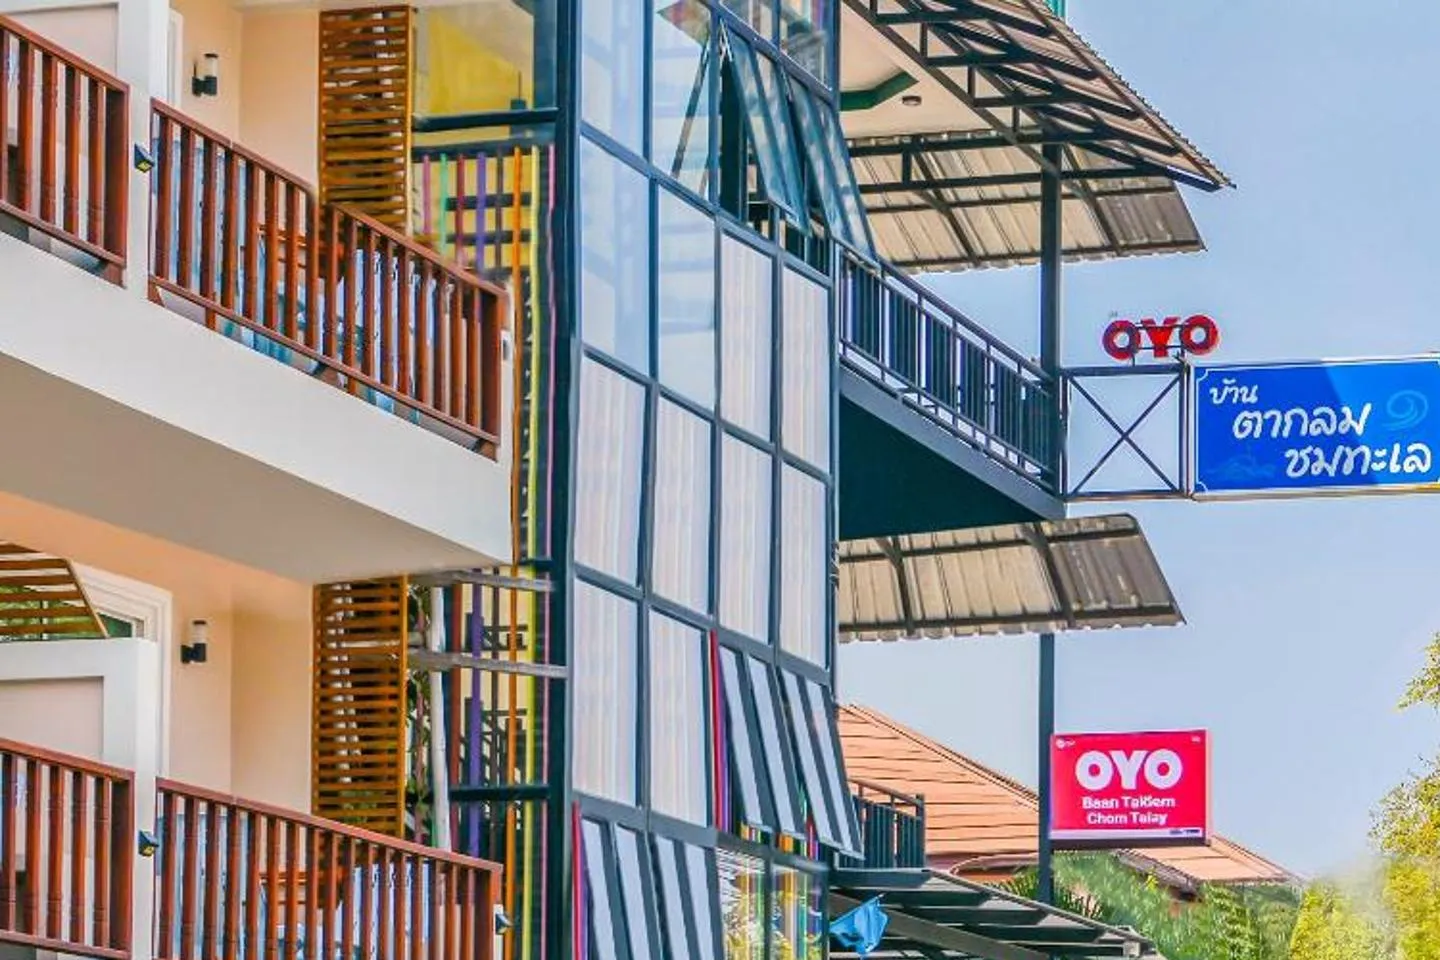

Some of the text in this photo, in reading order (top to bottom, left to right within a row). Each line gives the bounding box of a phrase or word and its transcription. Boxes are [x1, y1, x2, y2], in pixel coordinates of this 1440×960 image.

[1103, 315, 1219, 359] OYO
[1210, 378, 1259, 404] บ้าน
[1232, 403, 1372, 438] ตากลม
[1284, 442, 1432, 477] ชมทะเล
[1075, 748, 1183, 791] OYO
[1087, 812, 1128, 824] Chom
